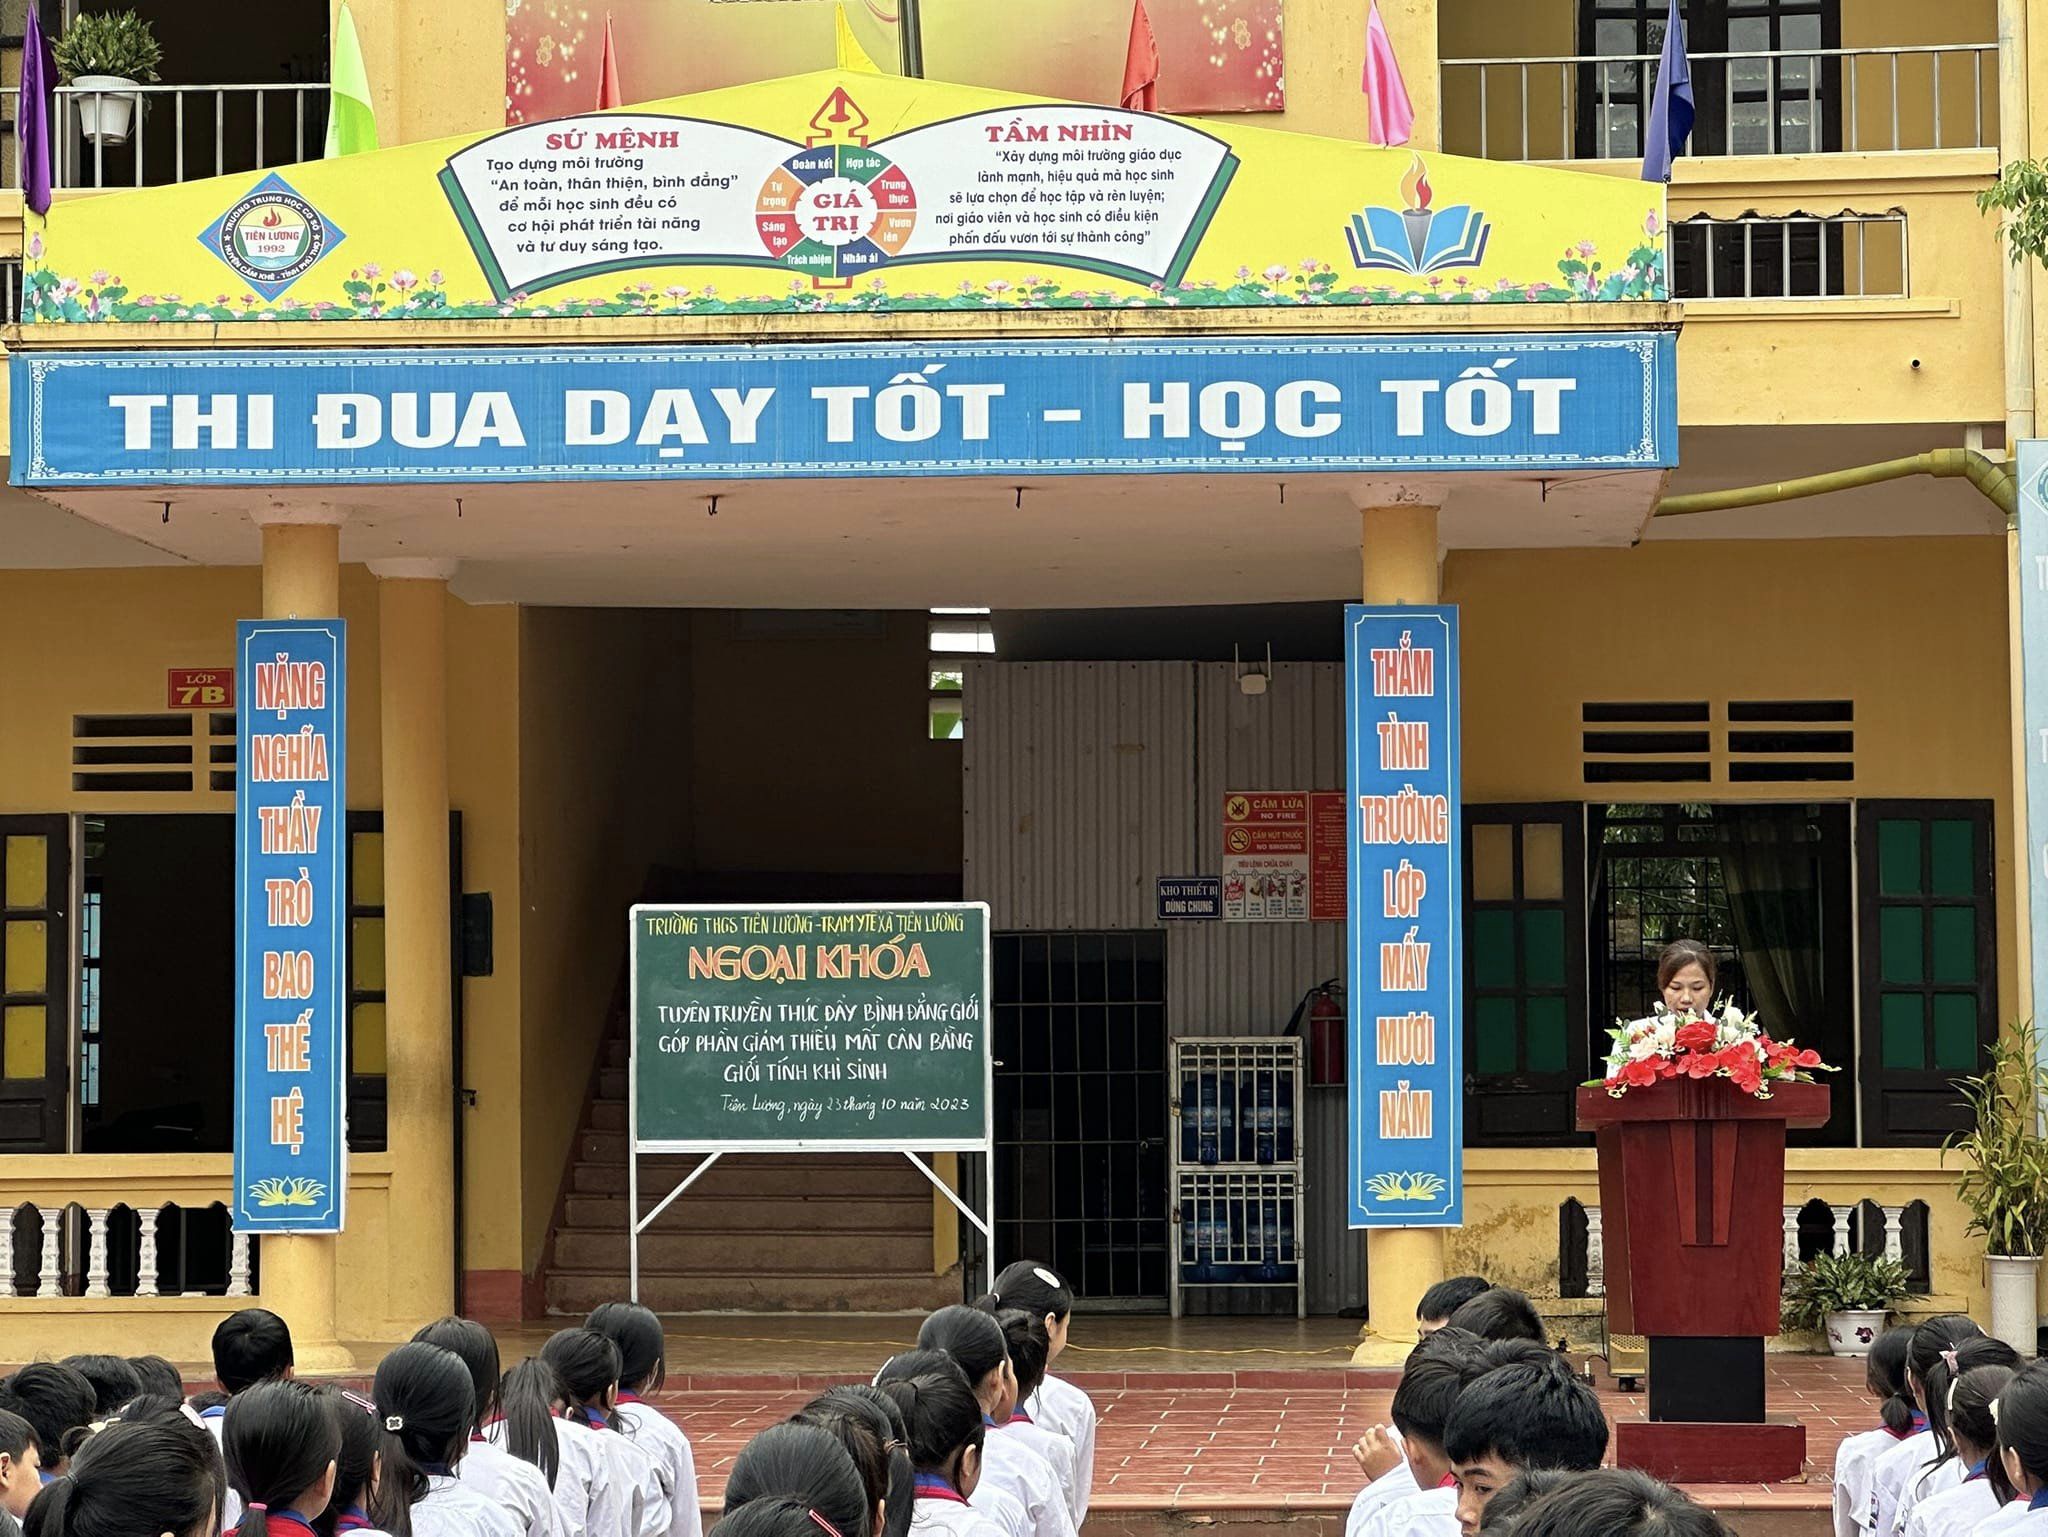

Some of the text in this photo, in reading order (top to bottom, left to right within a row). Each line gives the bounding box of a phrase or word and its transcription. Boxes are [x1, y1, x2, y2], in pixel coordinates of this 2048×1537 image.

[985, 117, 1134, 142] TẦM NHÌN
[546, 127, 679, 153] SỨ MỆNH
[486, 156, 644, 173] Tạo dựng môi trường
[792, 157, 833, 170] Đoàn kết
[846, 157, 881, 171] Hợp tác
[1028, 151, 1059, 165] dựng
[1062, 149, 1084, 161] môi
[1088, 149, 1125, 164] trường
[1129, 148, 1156, 163] giáo
[1160, 149, 1182, 163] dục
[524, 178, 562, 191] toàn,
[567, 177, 601, 189] thân
[606, 176, 648, 192] thiện,
[653, 175, 685, 188] bình
[880, 179, 907, 191] Trung
[978, 168, 1174, 185] lành mạnh, hiệu quả mà học sinh
[250, 195, 283, 206] TRUNG
[499, 194, 677, 213] để mỗi học sinh đều có
[763, 196, 787, 208] trọng
[813, 189, 863, 208] GIÁ
[889, 193, 909, 206] thực
[949, 187, 1165, 206] sẽ lựa chọn để học tập và rèn luyện;
[508, 214, 700, 235] cơ hội phát triển tài năng
[813, 215, 859, 234] TRỊ
[935, 207, 1159, 227] nơi giáo viên và học sinh có điều kiện
[762, 221, 786, 233] Sáng
[883, 231, 898, 242] lên
[516, 239, 663, 254] và tư duy sáng tạo.
[773, 235, 788, 248] tạo
[949, 229, 1110, 246] phấn đấu vươn tới sự thành
[258, 245, 285, 253] 1992
[843, 253, 866, 264] Nhân
[787, 254, 808, 265] Trách
[109, 358, 1577, 458] THI ĐUA DẠY TỐT HỌC TỐT
[1370, 630, 1434, 697] THẮM
[186, 672, 217, 684] LỚP
[255, 652, 325, 720] NẶNG
[176, 686, 225, 704] 7B
[1377, 712, 1429, 771] TÌNH
[252, 724, 329, 782] NGHĨA
[1253, 797, 1304, 809] CẤM LỬA
[258, 789, 322, 854] THẦY
[1360, 783, 1448, 845] TRƯỜNG
[265, 866, 313, 927] TRÒ
[1160, 882, 1218, 898] KHO THIẾT BỊ
[1383, 858, 1427, 918] LỚP
[1165, 899, 1186, 912] DÙNG
[1187, 900, 1213, 912] CHUNG
[645, 912, 698, 936] TRƯỜNG
[741, 912, 769, 934] TIÊN
[773, 914, 812, 934] LƯƠNG
[896, 911, 921, 933] TIÊN
[925, 911, 964, 933] LƯƠNG
[688, 933, 931, 985] NGOẠI KHÓA
[1380, 925, 1431, 992] MẤY
[263, 950, 314, 1000] BAO
[657, 1000, 710, 1024] TUYÊN
[713, 996, 772, 1024] TRUYỀN
[777, 997, 819, 1023] THÚC
[864, 995, 903, 1022] BÌNH
[907, 992, 949, 1022] ĐẲNG
[950, 993, 979, 1021] GIỚI
[264, 1008, 314, 1072] THẾ
[658, 1023, 974, 1053] GÓP PHẦN MẤT CÂN BẰNG
[1376, 1011, 1435, 1066] MƯƠI
[723, 1055, 760, 1083] GIỚI
[766, 1056, 808, 1081] TÍNH
[847, 1058, 887, 1080] SINH
[793, 1098, 823, 1122] ngày
[827, 1097, 842, 1111] 23
[842, 1094, 876, 1120] tháng
[881, 1098, 897, 1111] 10
[900, 1097, 926, 1111] năm
[930, 1098, 970, 1111] 2023
[1379, 1080, 1433, 1139] NĂM
[271, 1086, 304, 1155] HỆ
